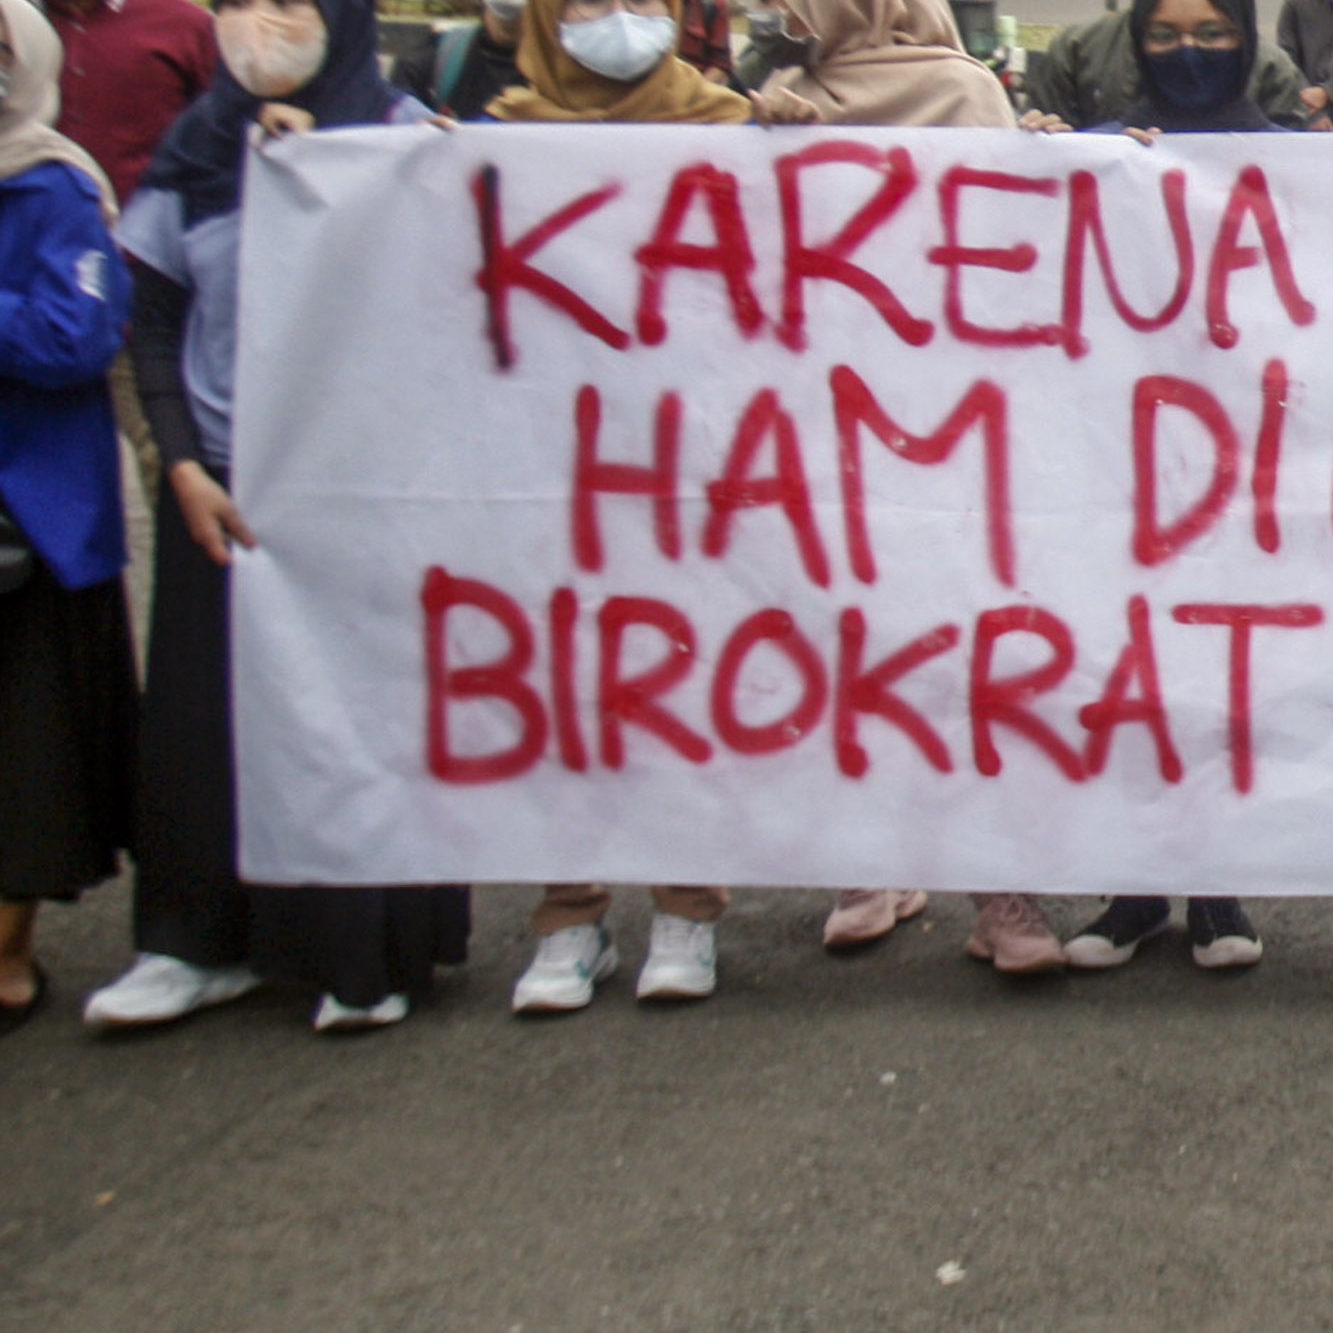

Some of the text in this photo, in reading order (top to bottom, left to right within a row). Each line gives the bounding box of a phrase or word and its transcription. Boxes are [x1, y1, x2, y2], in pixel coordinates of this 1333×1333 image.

[470, 139, 1317, 371] KARENA
[570, 363, 1017, 588] HAM
[420, 565, 1326, 794] BIROKRAT
